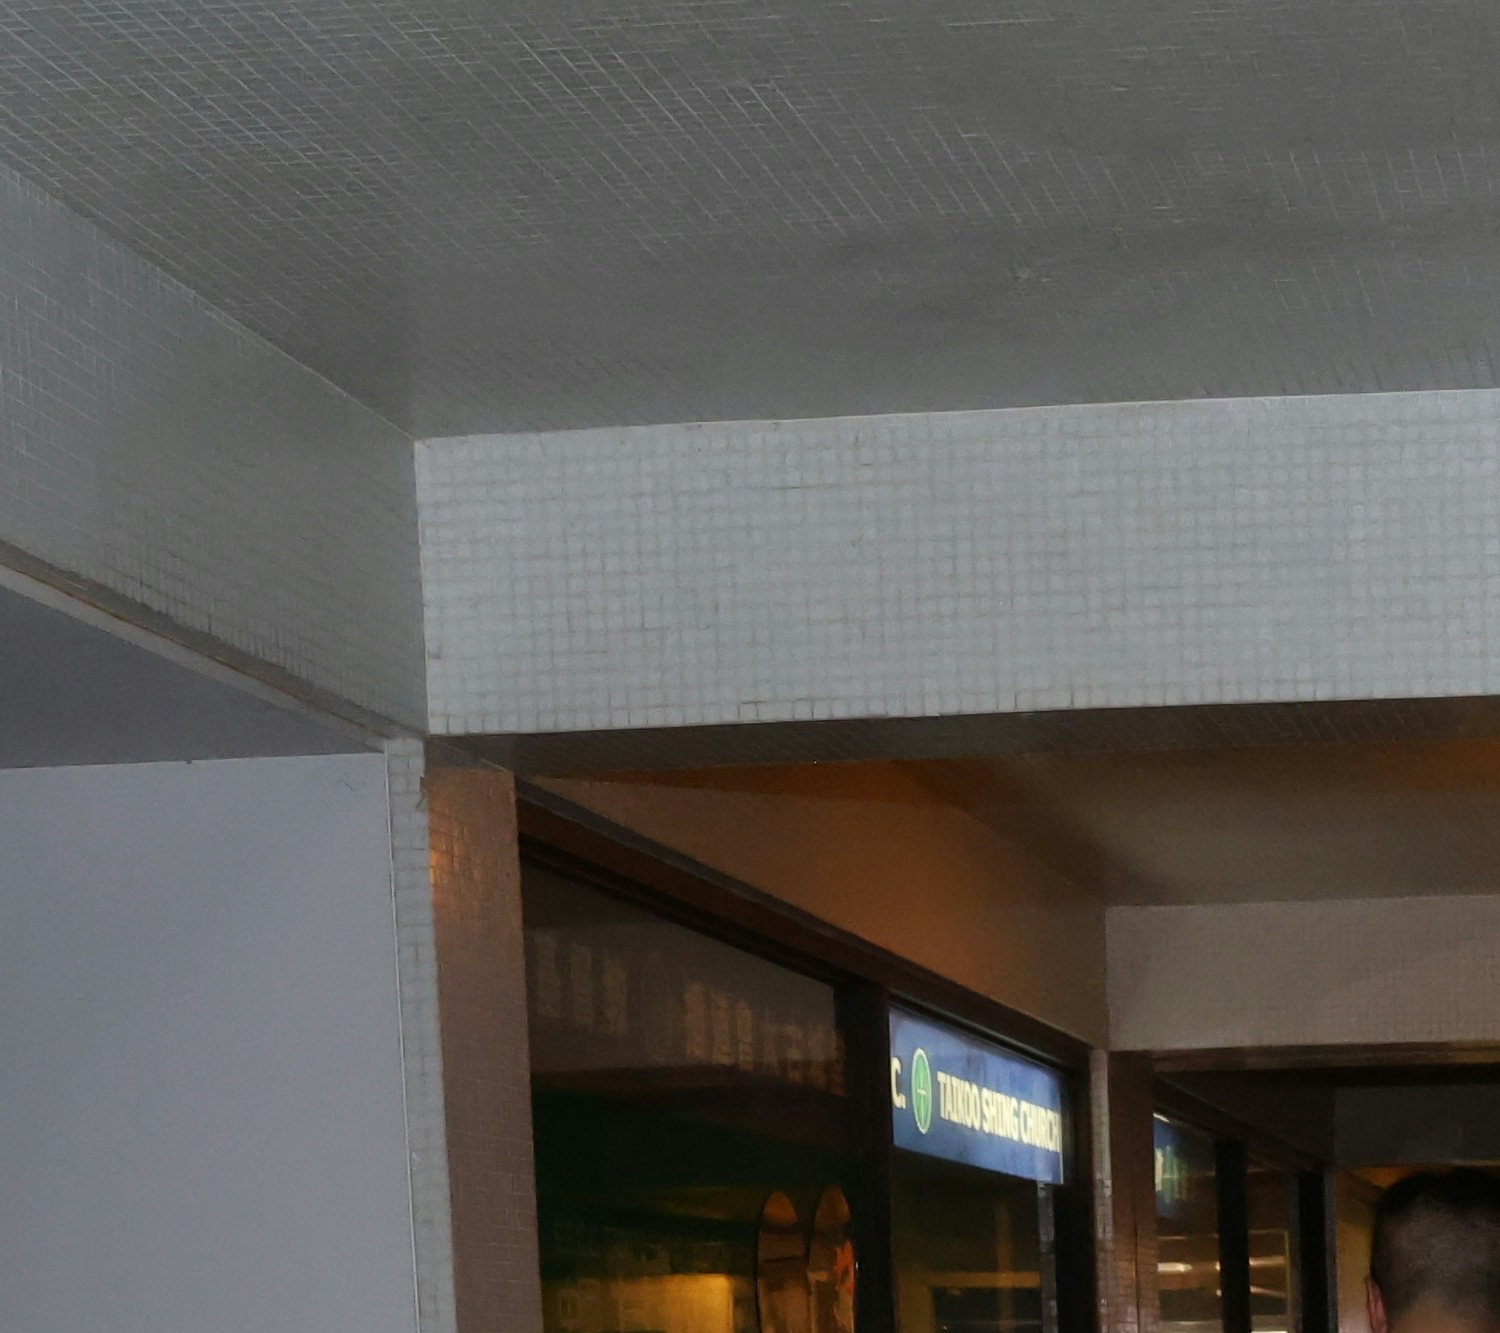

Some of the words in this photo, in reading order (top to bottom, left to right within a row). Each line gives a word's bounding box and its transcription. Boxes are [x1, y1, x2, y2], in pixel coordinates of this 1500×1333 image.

[936, 1071, 981, 1131] TAIKOO
[981, 1086, 1019, 1142] SHING
[1019, 1099, 1062, 1153] CHURCH
